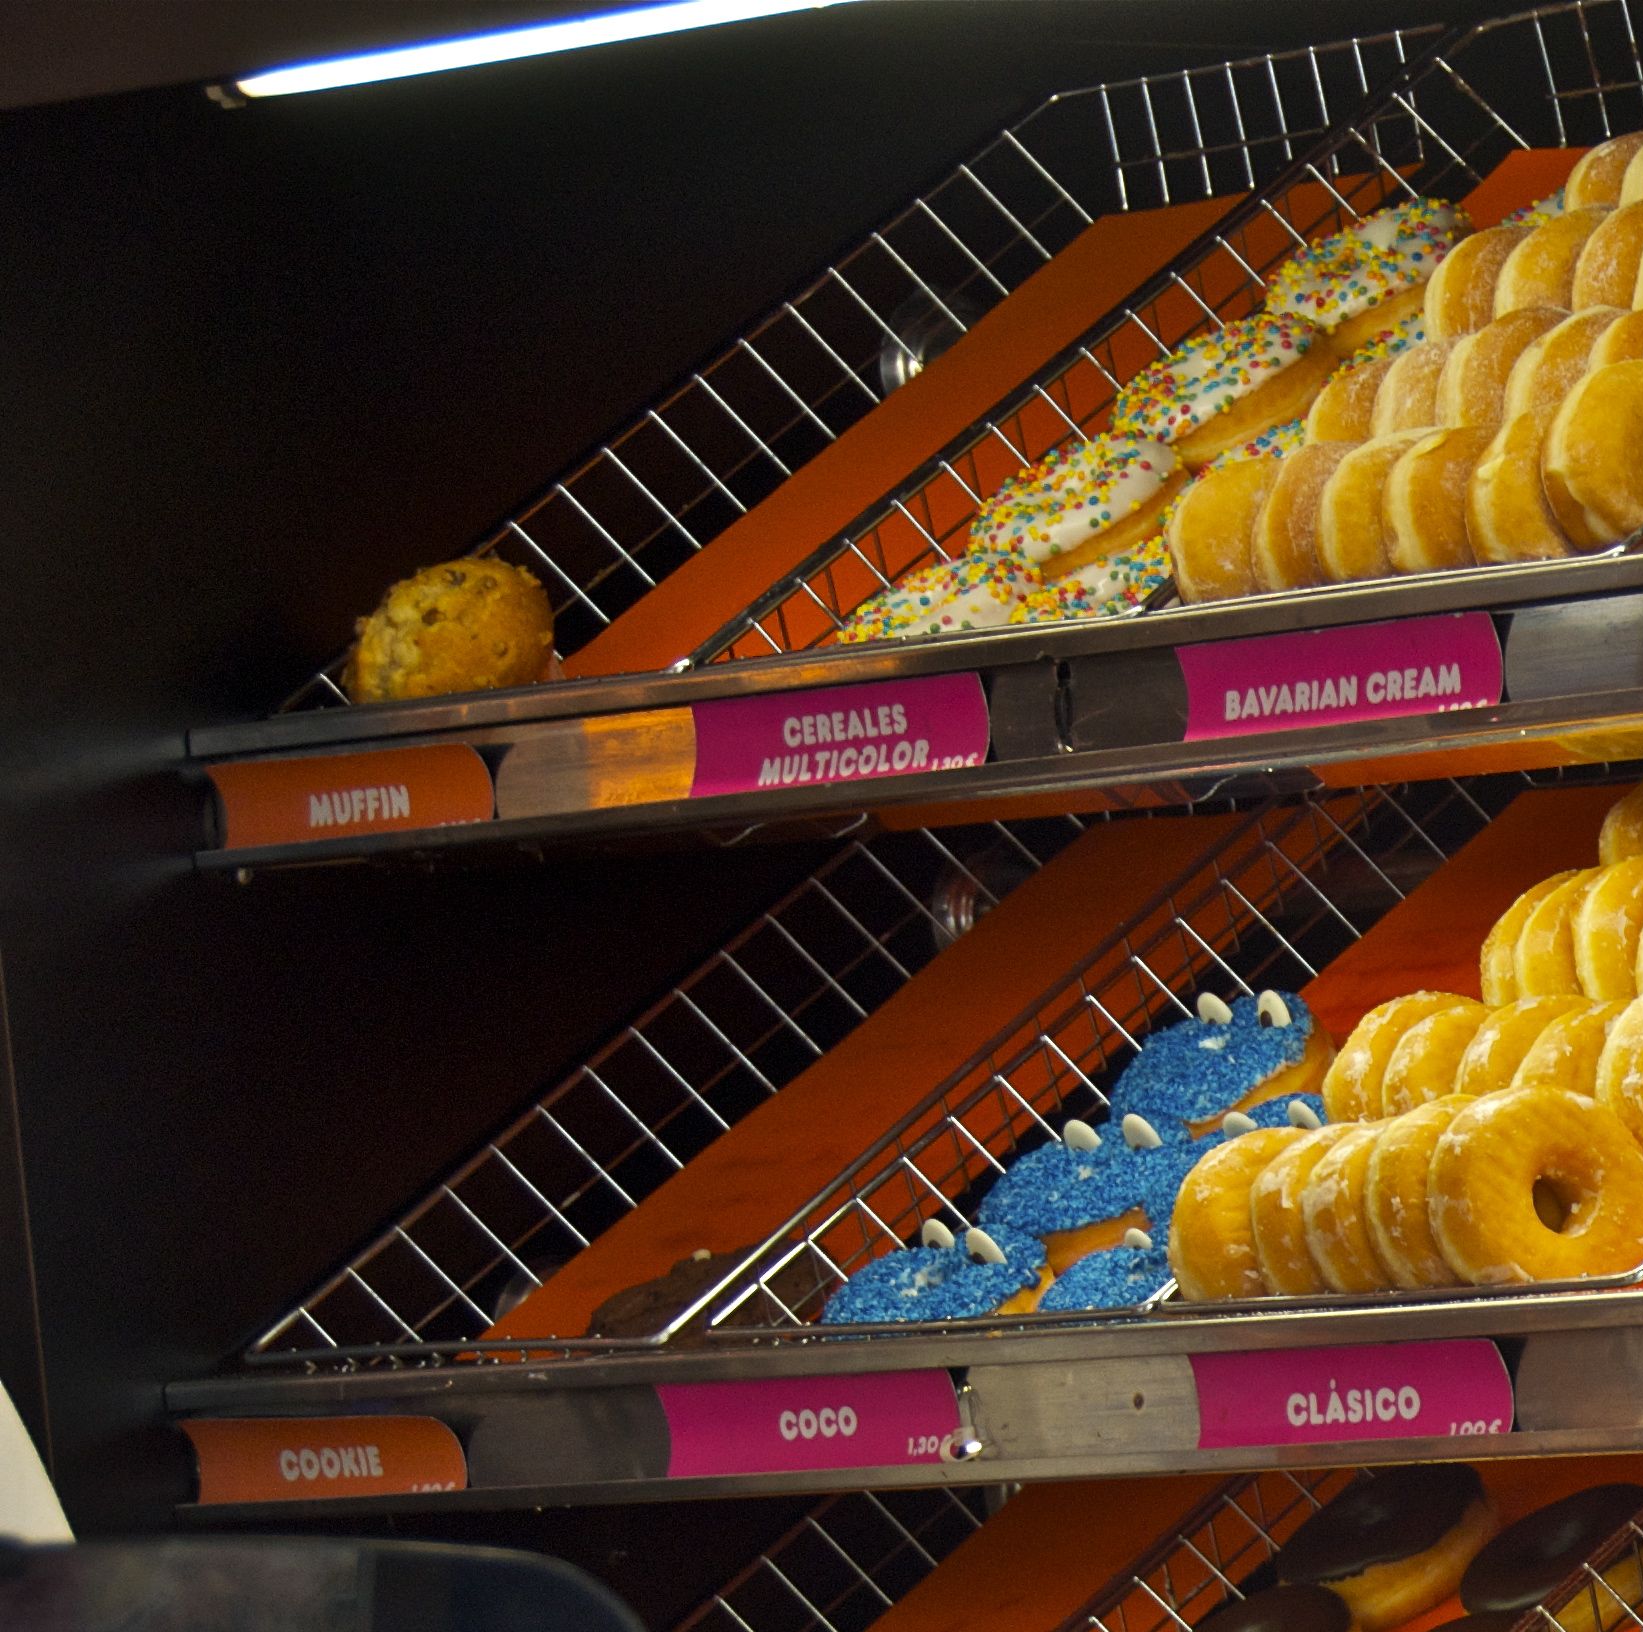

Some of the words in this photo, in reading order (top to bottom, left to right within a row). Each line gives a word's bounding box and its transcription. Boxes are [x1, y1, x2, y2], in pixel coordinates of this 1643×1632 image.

[1225, 676, 1357, 720] BAVARIAN
[1366, 663, 1461, 704] CREAM
[783, 704, 907, 747] CEREALES
[758, 739, 929, 786] MULTICOLOR
[309, 785, 411, 827] MUFFIN
[779, 1405, 858, 1441] COCO
[1287, 1378, 1421, 1427] CLÁSICO
[279, 1445, 384, 1482] COOKIE
